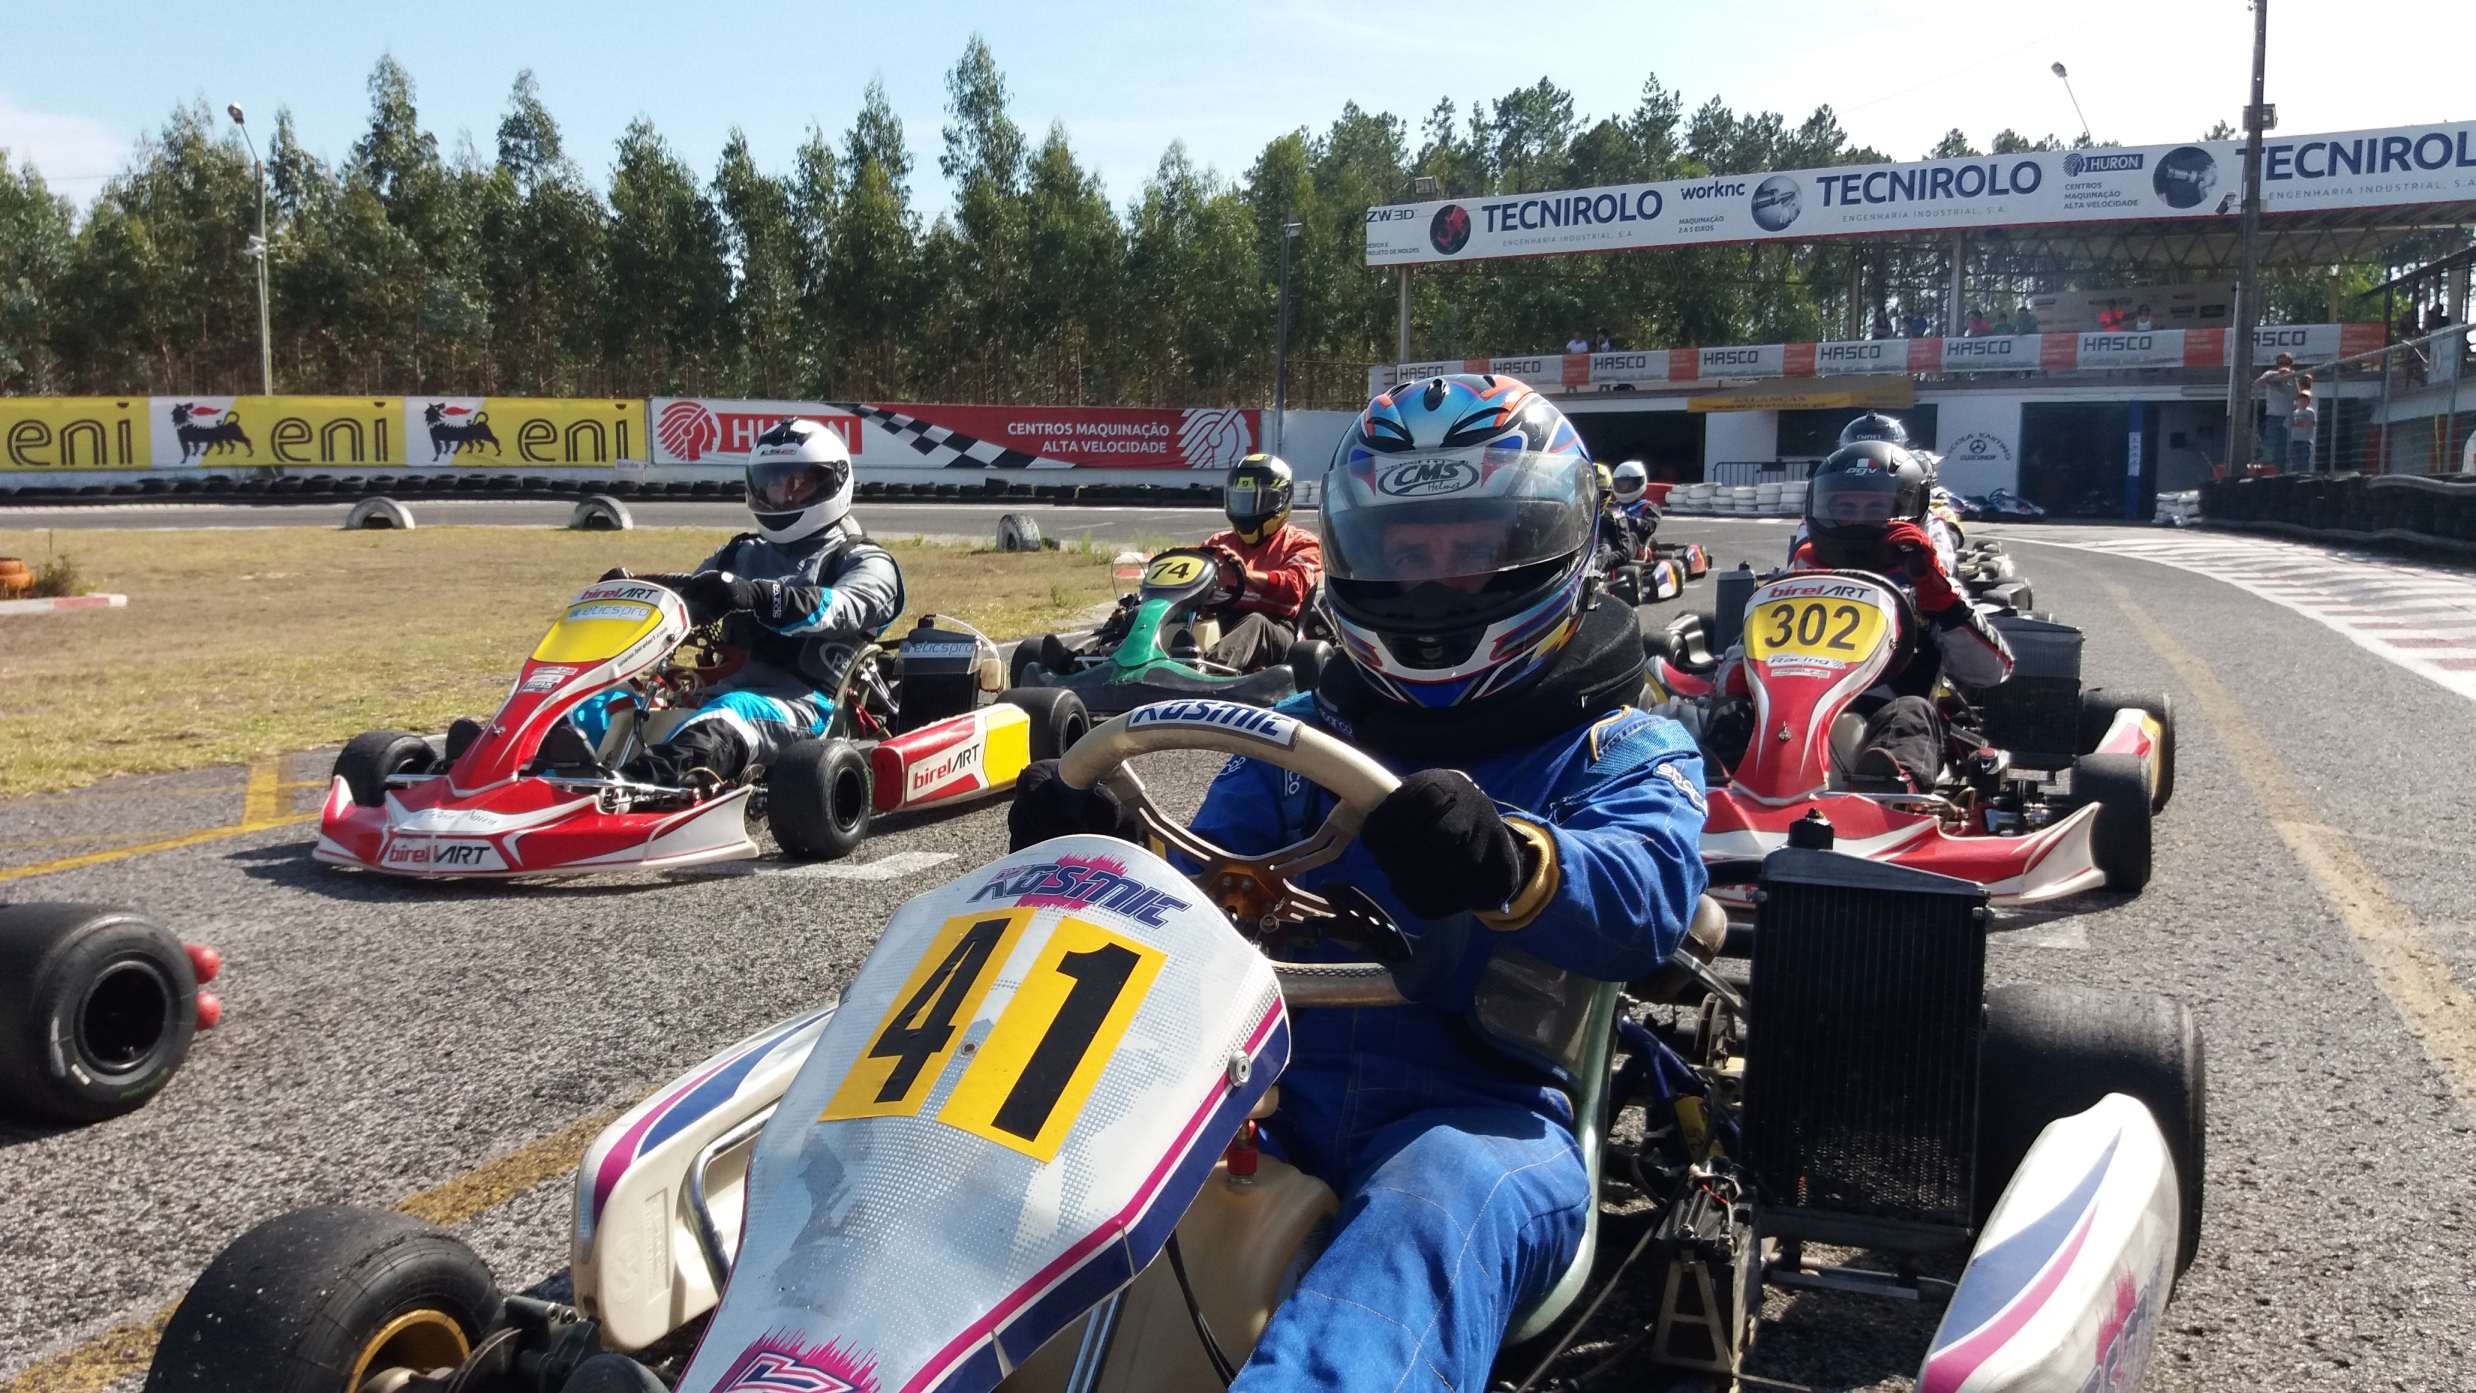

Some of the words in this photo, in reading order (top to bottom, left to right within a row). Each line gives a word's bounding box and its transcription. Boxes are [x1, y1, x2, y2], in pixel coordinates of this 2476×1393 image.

[2090, 156, 2139, 170] HURON
[2236, 131, 2476, 181] ECNIROL
[1681, 181, 1746, 200] worknc
[1816, 161, 2042, 207] TECNIROLO
[2065, 182, 2102, 191] CENTROS
[2064, 190, 2121, 200] MAQUINAÇÃO
[2269, 186, 2353, 200] ENGENHARIA
[1482, 190, 1663, 232] TECNIROLO
[2087, 199, 2138, 208] VELOCIDADE
[1842, 210, 1908, 222] ENGENHARIA
[2084, 336, 2152, 352] HASCO
[2252, 330, 2306, 348] ASCO
[1820, 345, 1881, 361] HASCO
[1947, 340, 2011, 357] HASCO
[1594, 355, 1646, 370] HASCO
[1703, 350, 1758, 366] HASCO
[1400, 365, 1444, 380] HASCO
[1493, 360, 1541, 374] HASCO
[7, 402, 133, 466] eni
[270, 402, 389, 464] eni
[517, 402, 631, 463] eni
[1007, 422, 1073, 436] CENTROS
[1076, 422, 1170, 438] MAQUINAÇÃO
[1042, 440, 1078, 452] ALTA
[1081, 441, 1168, 453] VELOCIDADE
[1394, 461, 1460, 486] CMS
[1151, 562, 1190, 580] 74
[581, 587, 658, 600] birelART
[1767, 584, 1872, 598] birelART
[1764, 602, 1861, 651] 302
[912, 743, 981, 790] birelART
[388, 844, 491, 865] birelART
[867, 916, 1142, 1142] 41
